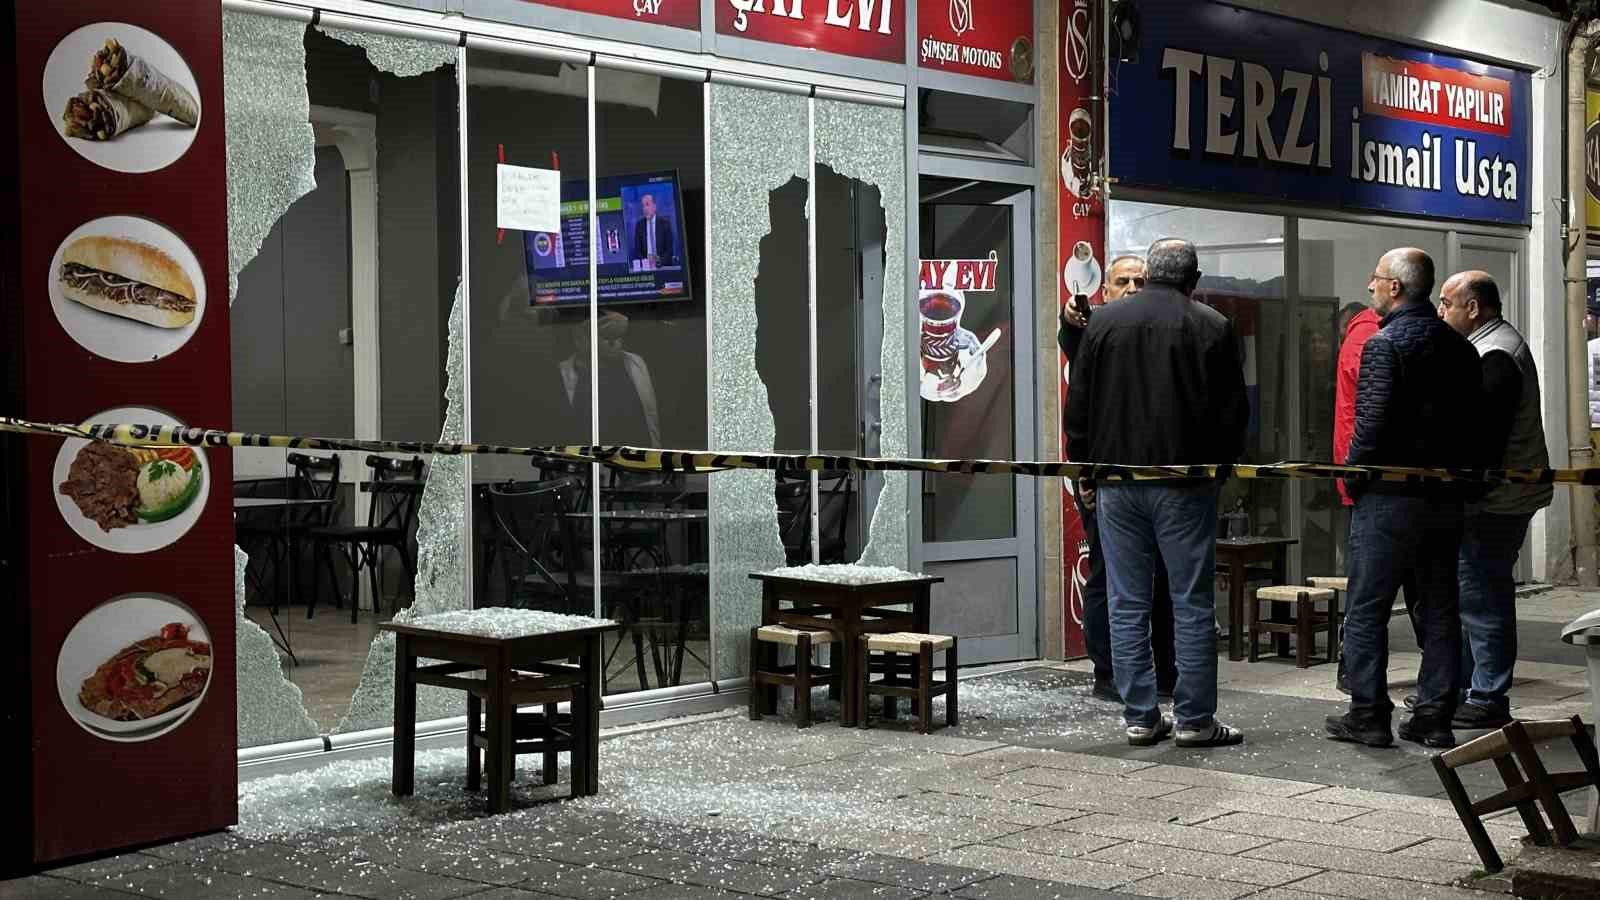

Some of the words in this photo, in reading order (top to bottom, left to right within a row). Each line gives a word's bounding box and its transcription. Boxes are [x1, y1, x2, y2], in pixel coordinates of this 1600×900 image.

[921, 34, 960, 65] ŞİMŞEK
[961, 47, 1002, 69] MOTORS
[1162, 48, 1332, 168] TERZİ
[1370, 67, 1441, 115] TAMİRAT
[1445, 83, 1505, 126] YAPILIR
[1350, 105, 1442, 191] İsmail
[1455, 138, 1518, 200] Usta
[1072, 202, 1092, 219] ÇAY
[919, 260, 951, 290] AY
